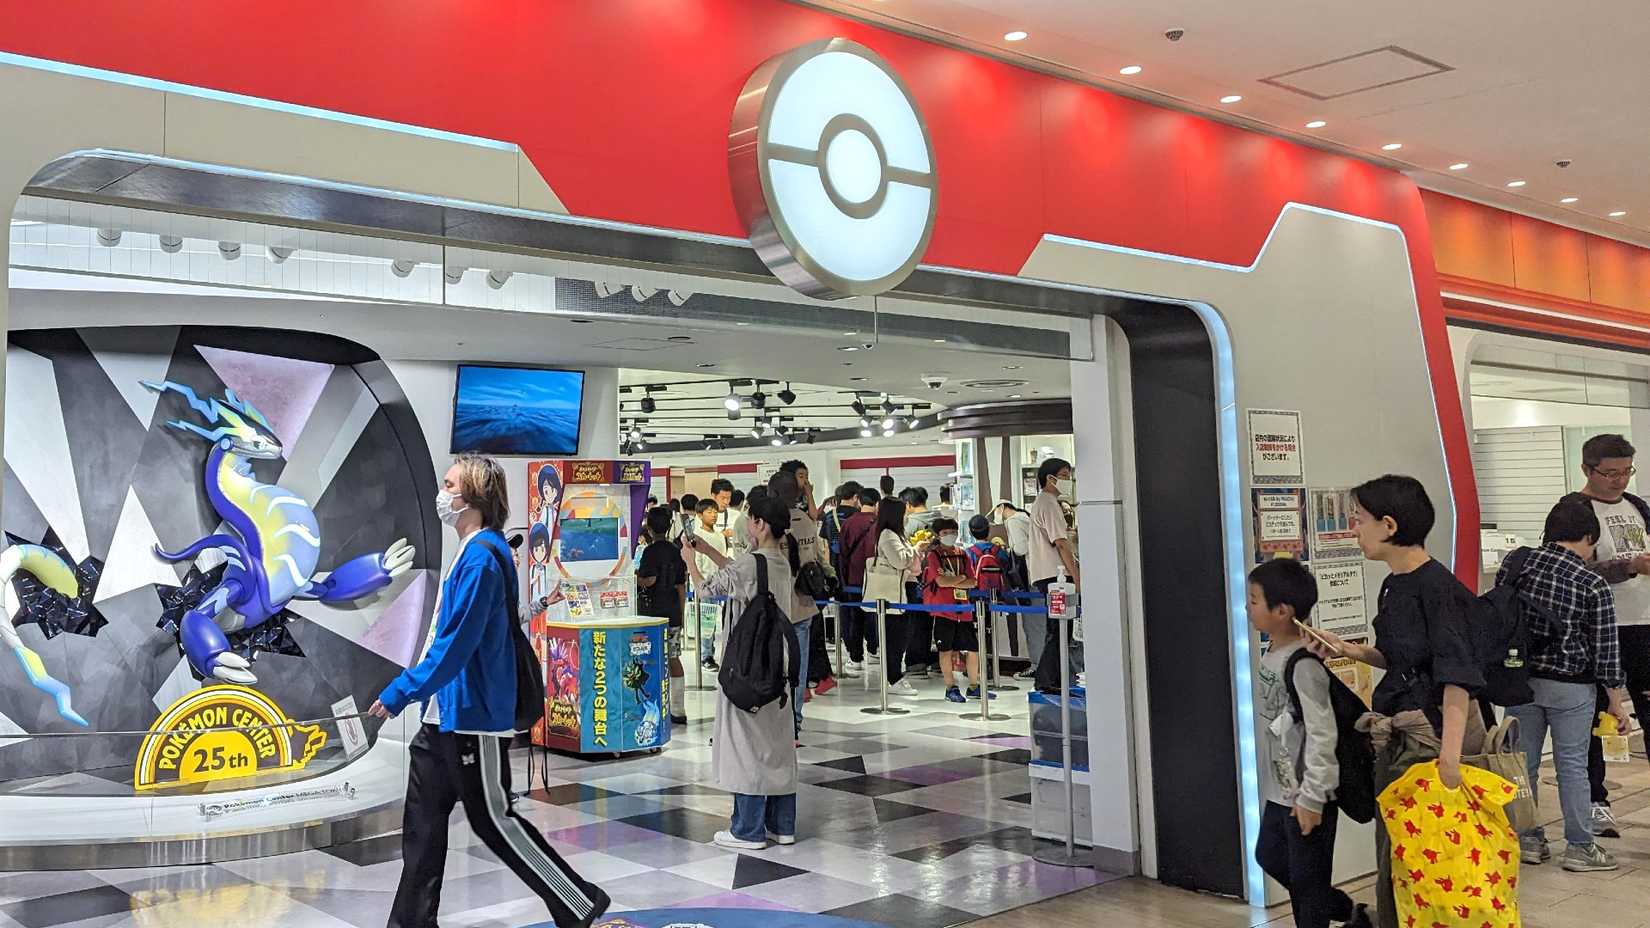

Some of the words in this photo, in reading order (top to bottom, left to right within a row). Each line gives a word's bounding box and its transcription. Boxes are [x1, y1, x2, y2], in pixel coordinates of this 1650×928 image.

[593, 631, 608, 747] 新たな2つの舞台へ
[193, 746, 248, 772] 25th
[232, 709, 276, 759] CENTER
